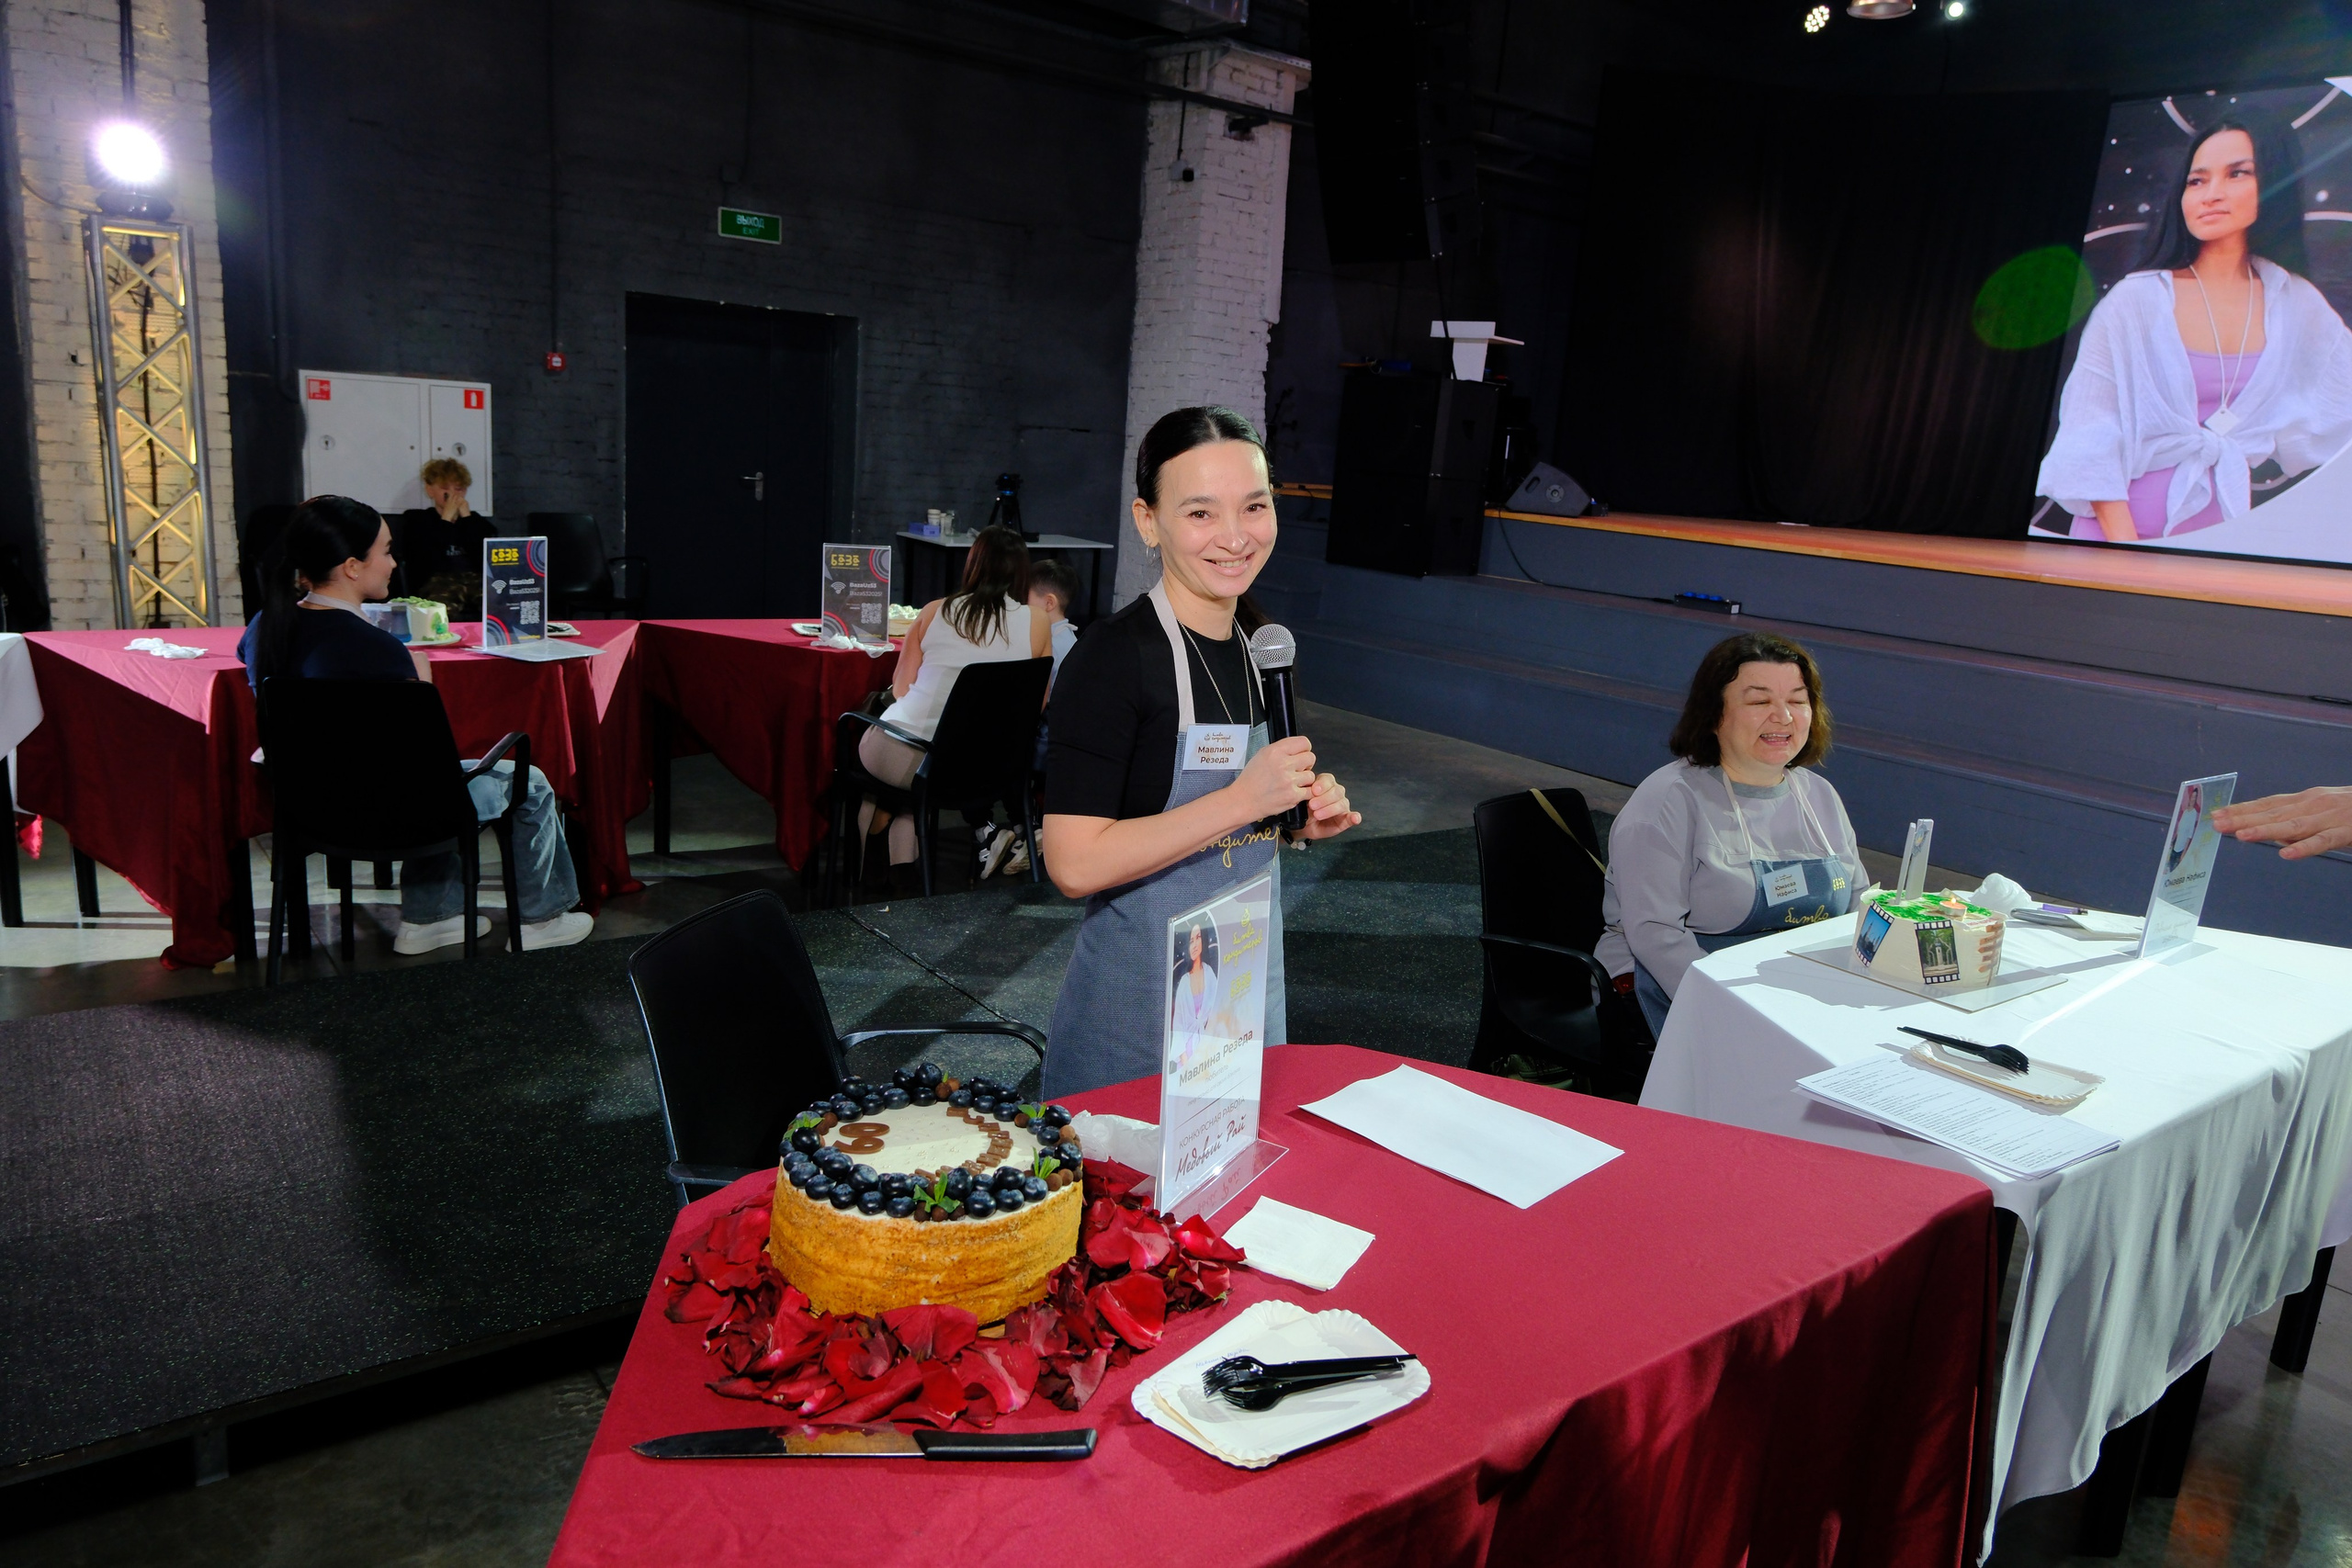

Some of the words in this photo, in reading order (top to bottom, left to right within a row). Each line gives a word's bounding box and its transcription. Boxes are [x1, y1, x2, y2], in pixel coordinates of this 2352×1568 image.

[736, 214, 765, 230] ВЫХОД
[742, 227, 760, 236] EXIT
[1200, 756, 1229, 764] Резеда
[1774, 881, 1796, 891] Юмаева
[1777, 888, 1797, 898] Нафиса
[1179, 1052, 1221, 1087] Мавлина
[1223, 1030, 1253, 1057] Резеда
[1179, 1111, 1222, 1149] КОНКУРСНАЯ
[1222, 1096, 1245, 1118] РАБОТА
[1174, 1133, 1223, 1182] Медовый
[1226, 1113, 1247, 1143] Рай
